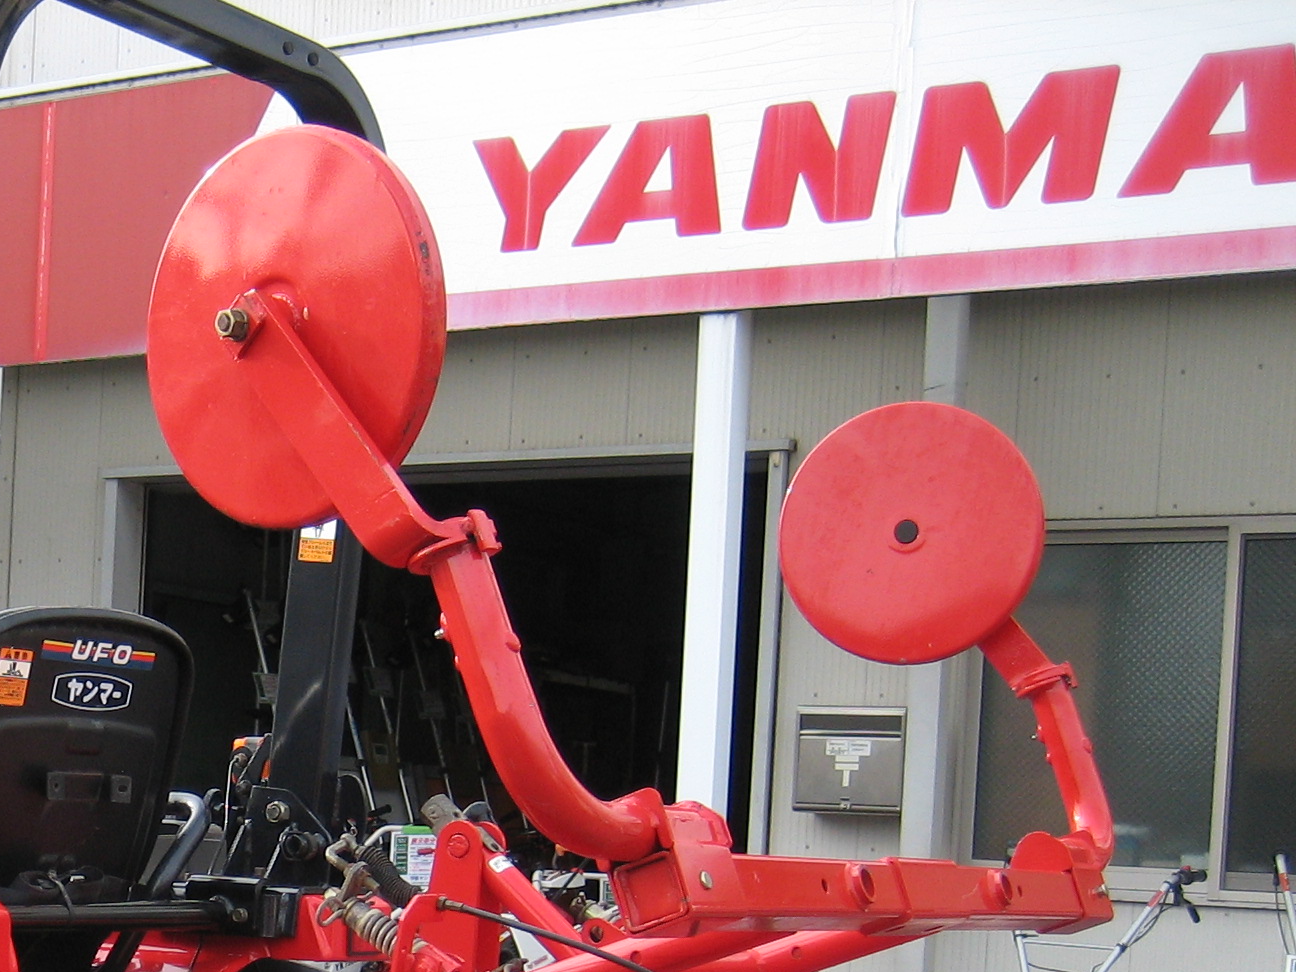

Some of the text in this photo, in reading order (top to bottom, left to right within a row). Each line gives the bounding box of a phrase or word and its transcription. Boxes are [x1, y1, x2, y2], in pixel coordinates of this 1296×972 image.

[71, 638, 133, 665] UFO
[67, 678, 122, 705] ヤンマー
